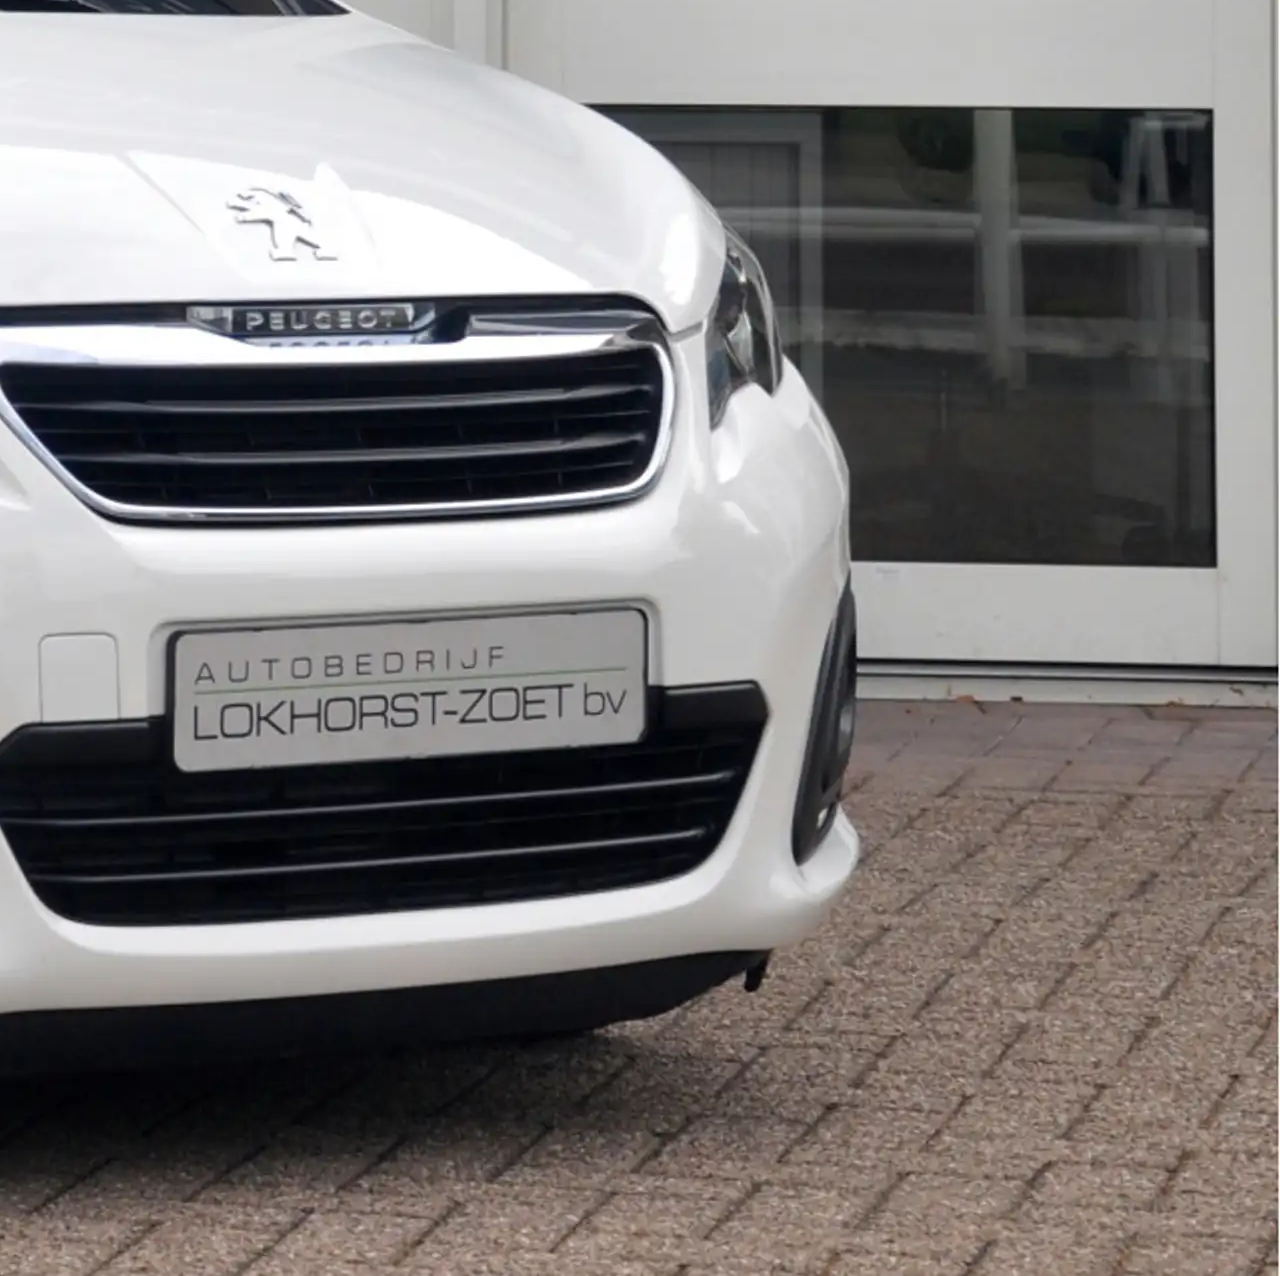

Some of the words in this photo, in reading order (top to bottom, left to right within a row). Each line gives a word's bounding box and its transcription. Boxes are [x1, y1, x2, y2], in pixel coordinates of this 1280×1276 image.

[246, 309, 396, 331] PEUGEOT
[194, 645, 506, 686] AUTOBEDRIJF
[193, 683, 575, 741] LOKHORST-ZOET
[583, 683, 628, 716] bv
